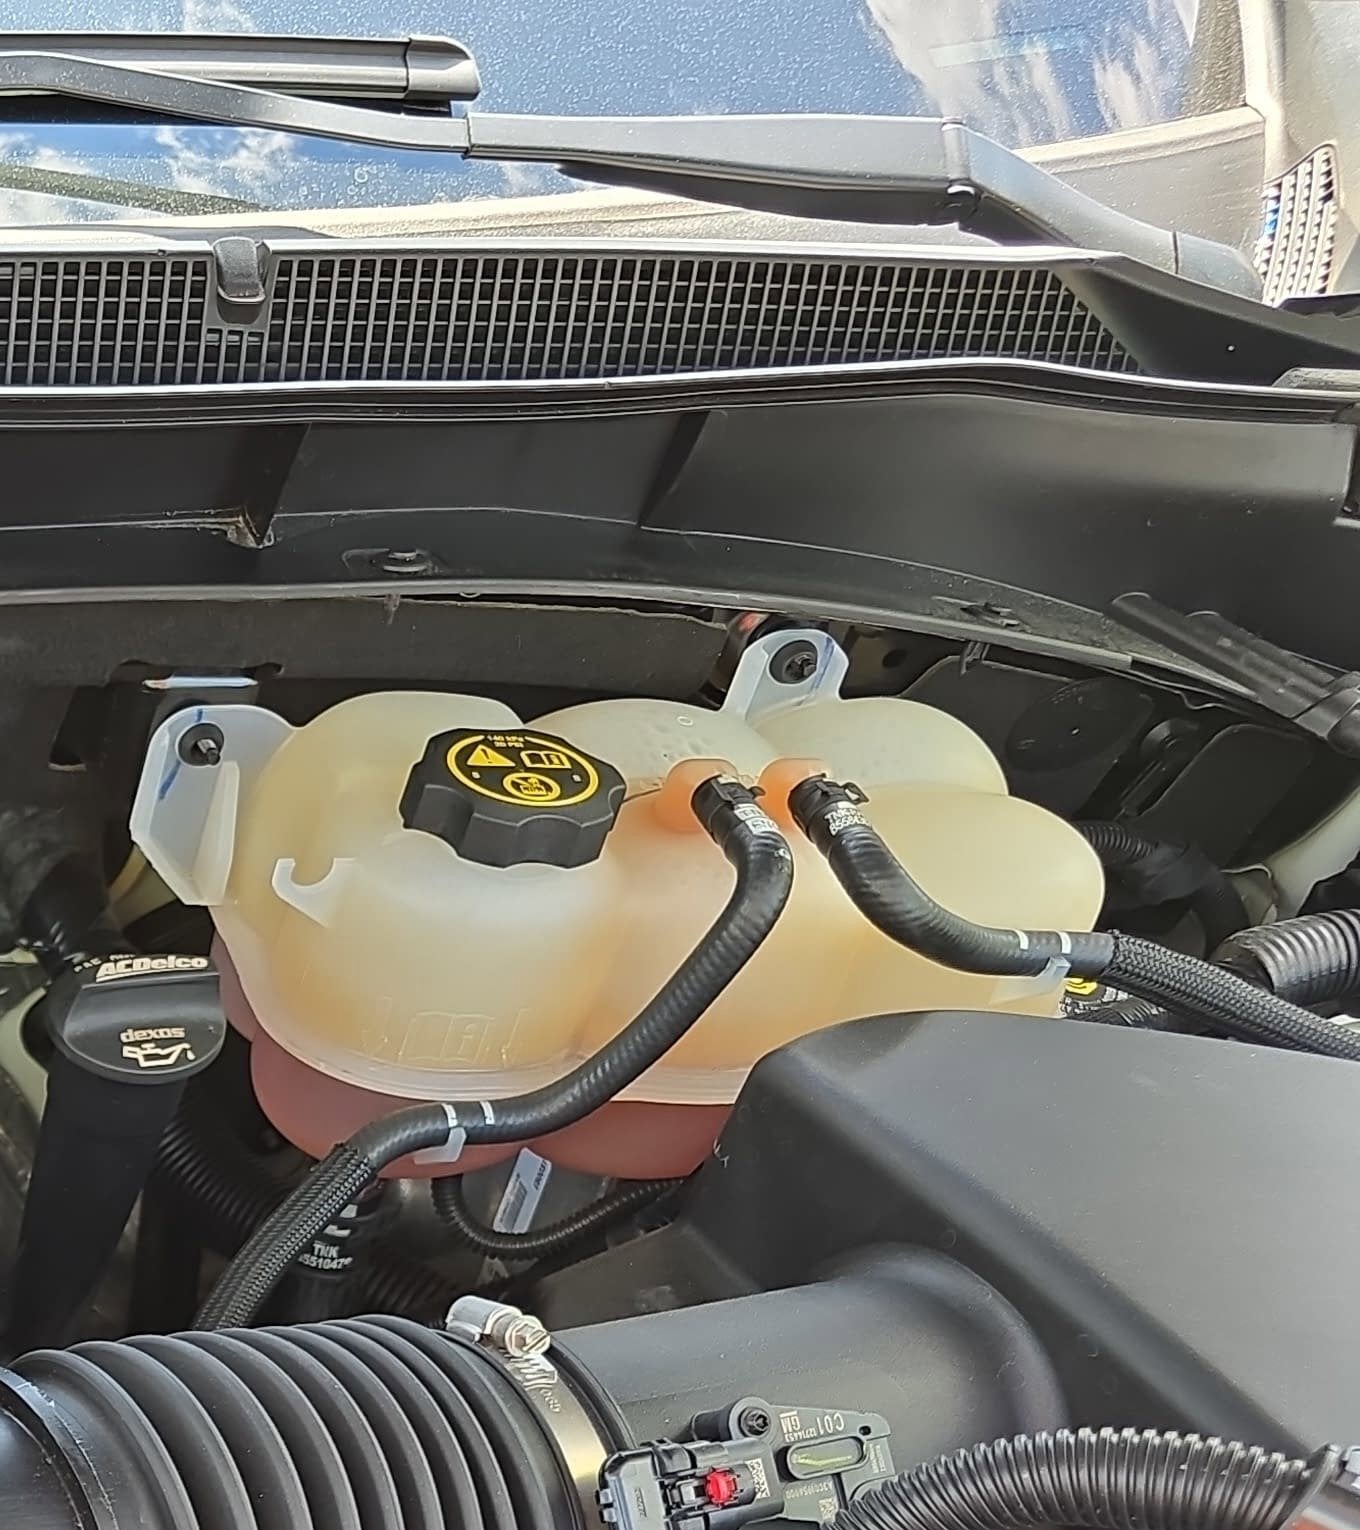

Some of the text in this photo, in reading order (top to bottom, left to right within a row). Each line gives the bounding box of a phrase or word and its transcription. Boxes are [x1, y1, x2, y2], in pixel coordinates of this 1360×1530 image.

[95, 955, 208, 980] ACDelco
[120, 1027, 185, 1043] dexos
[780, 1414, 801, 1434] GM
[816, 1412, 845, 1436] C01
